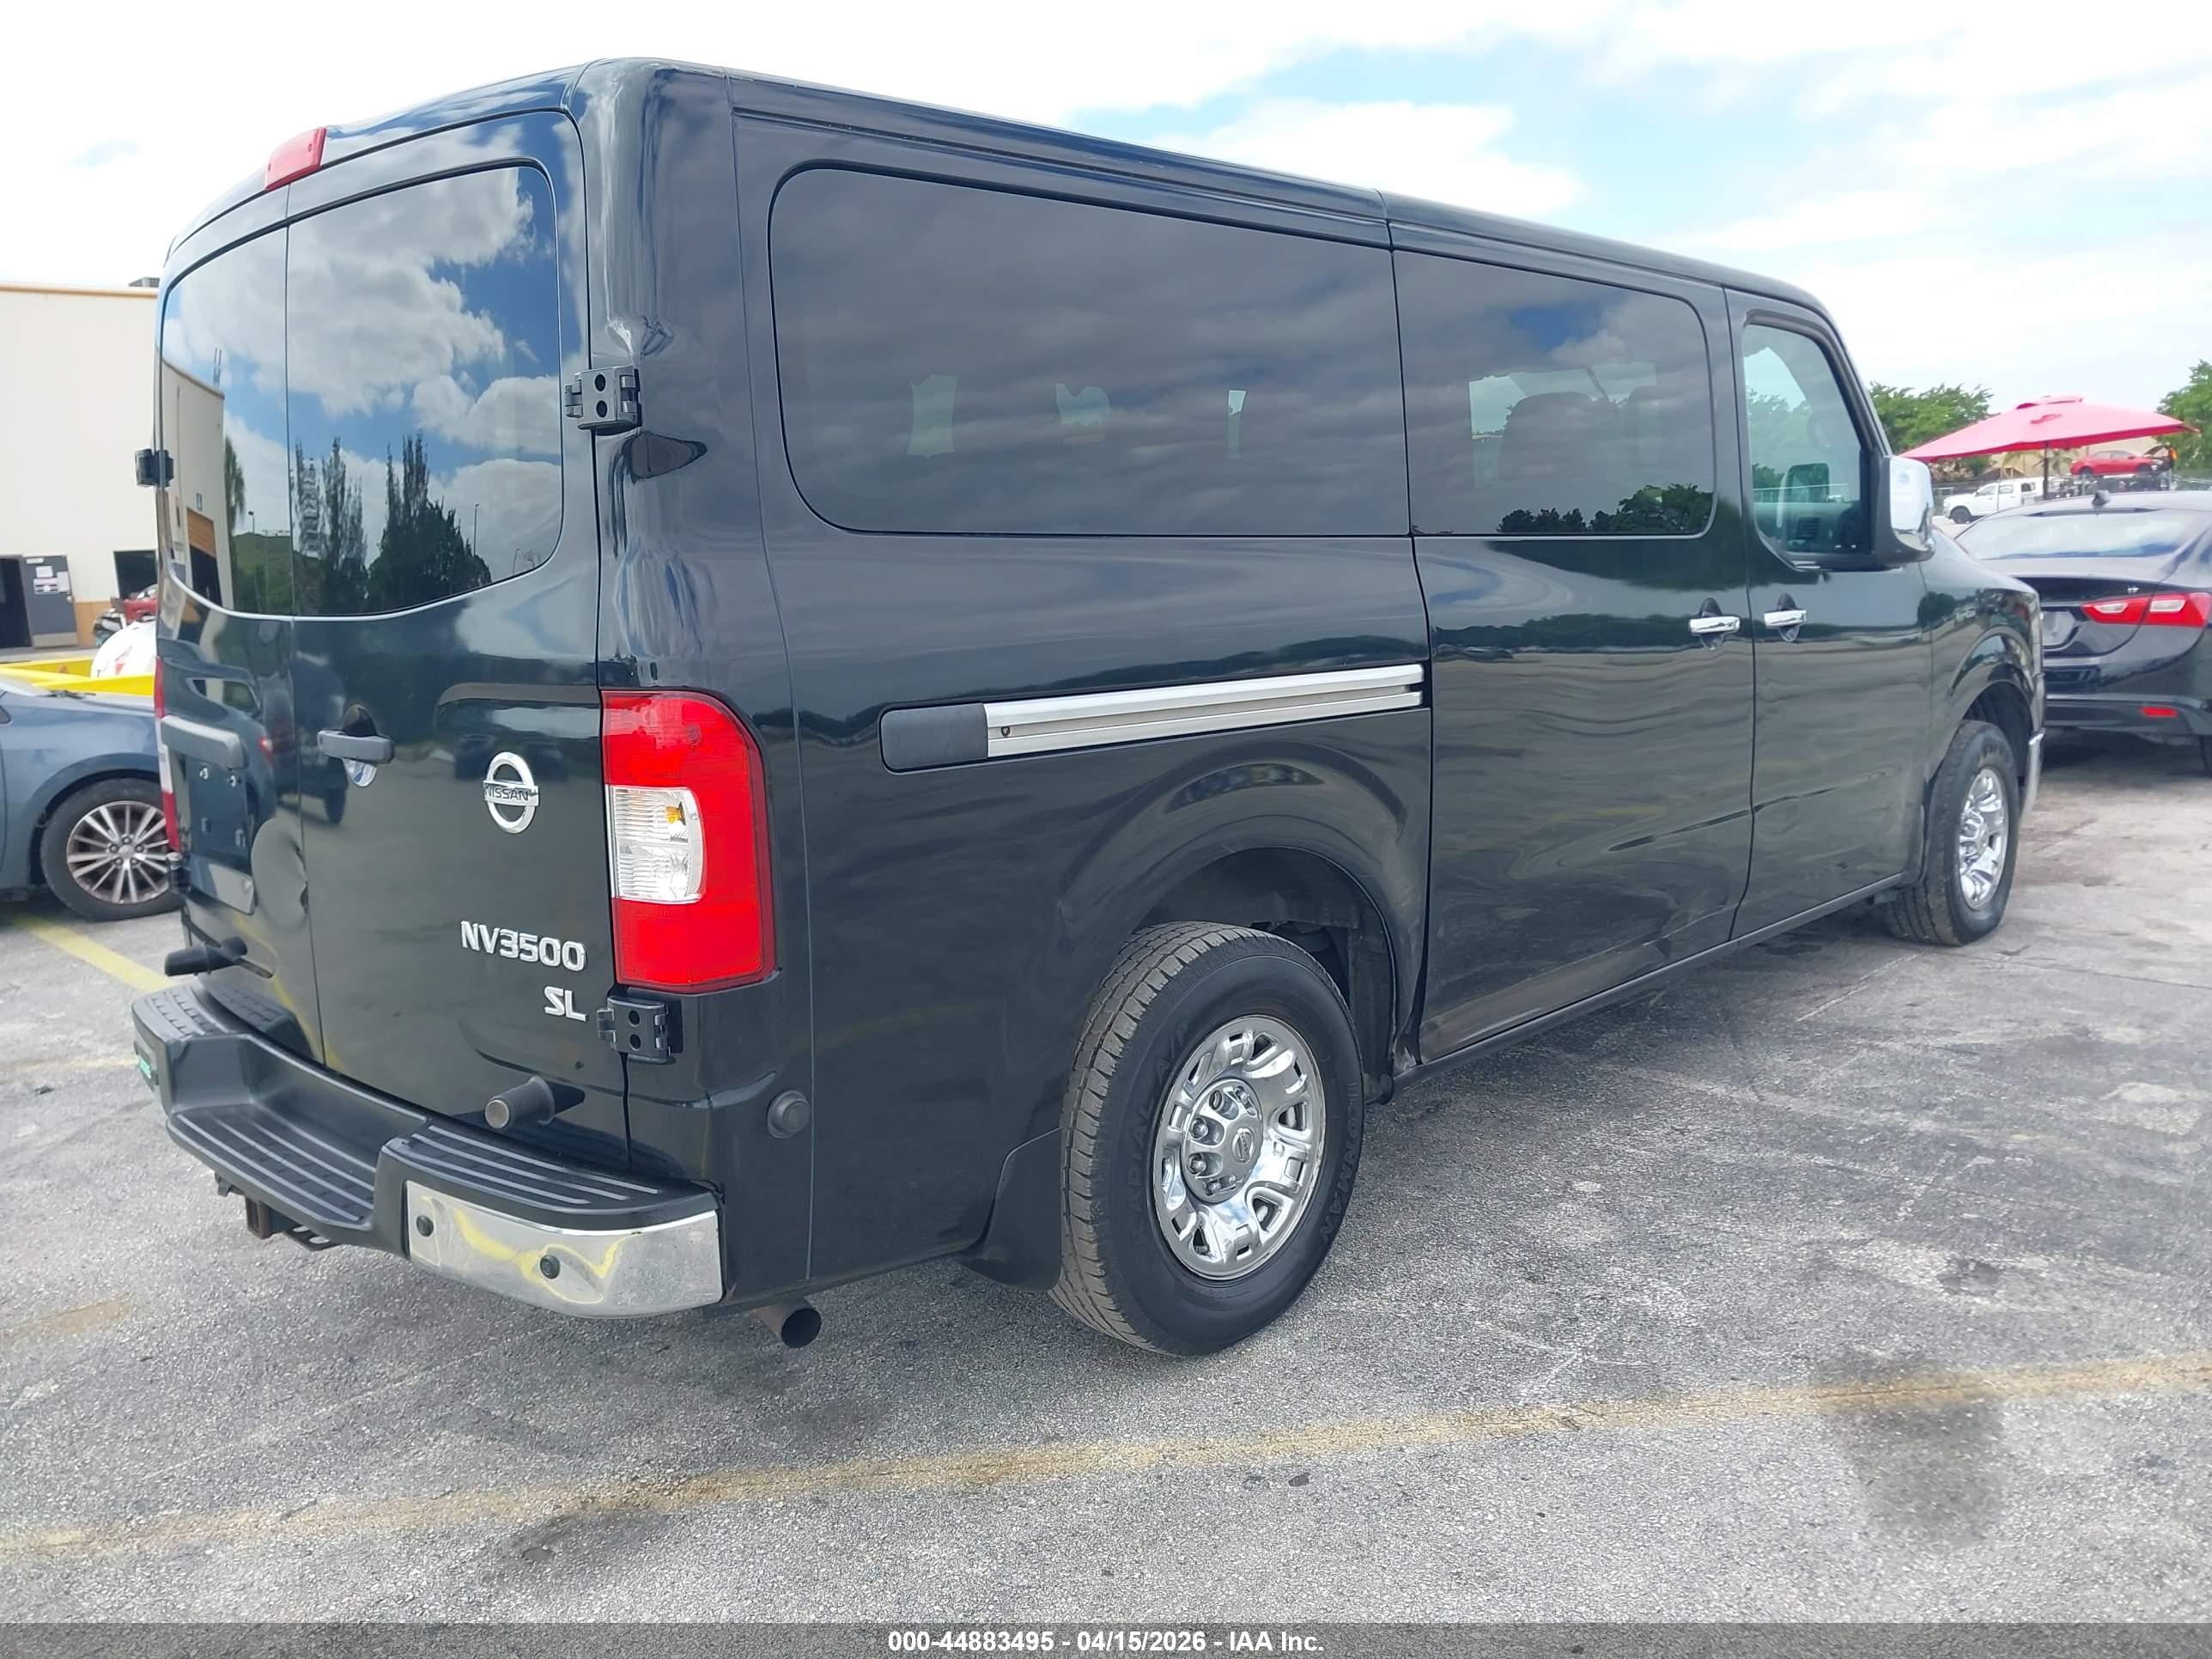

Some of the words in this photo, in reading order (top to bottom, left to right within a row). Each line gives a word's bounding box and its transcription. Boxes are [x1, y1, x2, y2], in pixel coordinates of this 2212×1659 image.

[484, 783, 529, 801] NISSAN
[460, 921, 586, 971] NV3500
[544, 986, 587, 1022] SL
